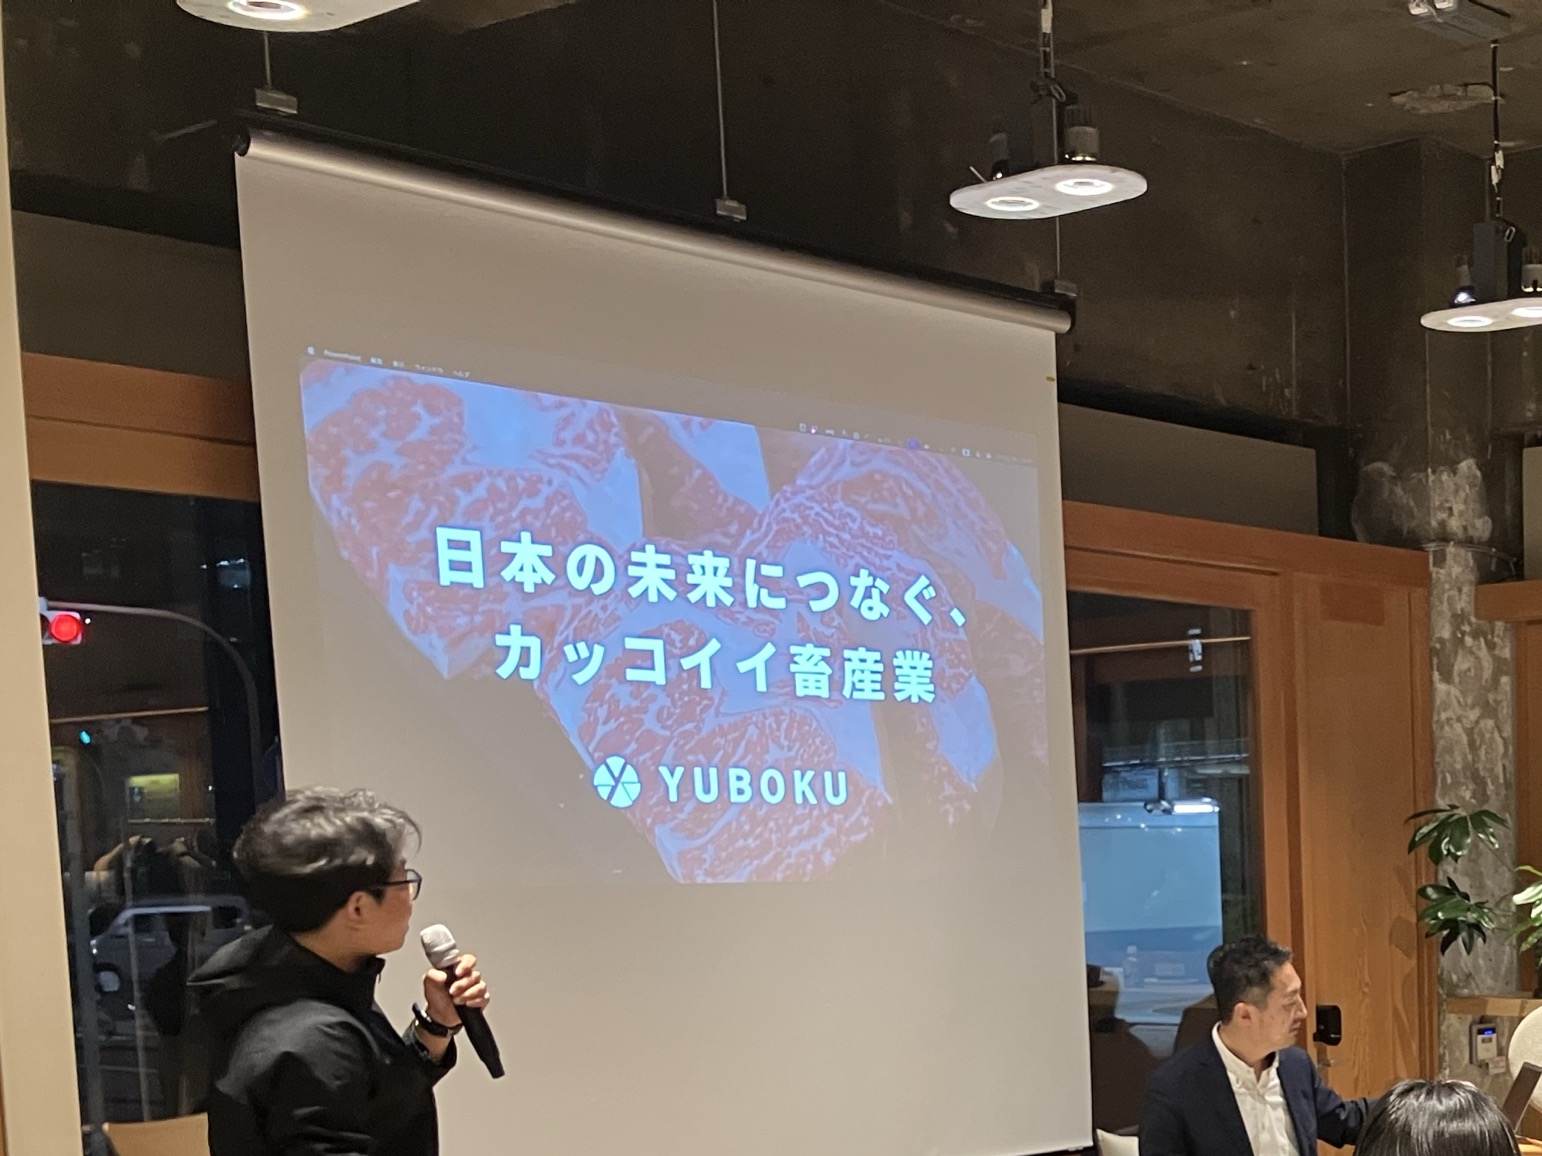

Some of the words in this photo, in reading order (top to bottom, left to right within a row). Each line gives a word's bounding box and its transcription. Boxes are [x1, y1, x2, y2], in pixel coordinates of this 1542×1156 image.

[435, 526, 967, 628] 日本の未来につなぐ、
[494, 623, 936, 704] カッコイイ畜産業
[658, 765, 848, 806] YUBOKU
